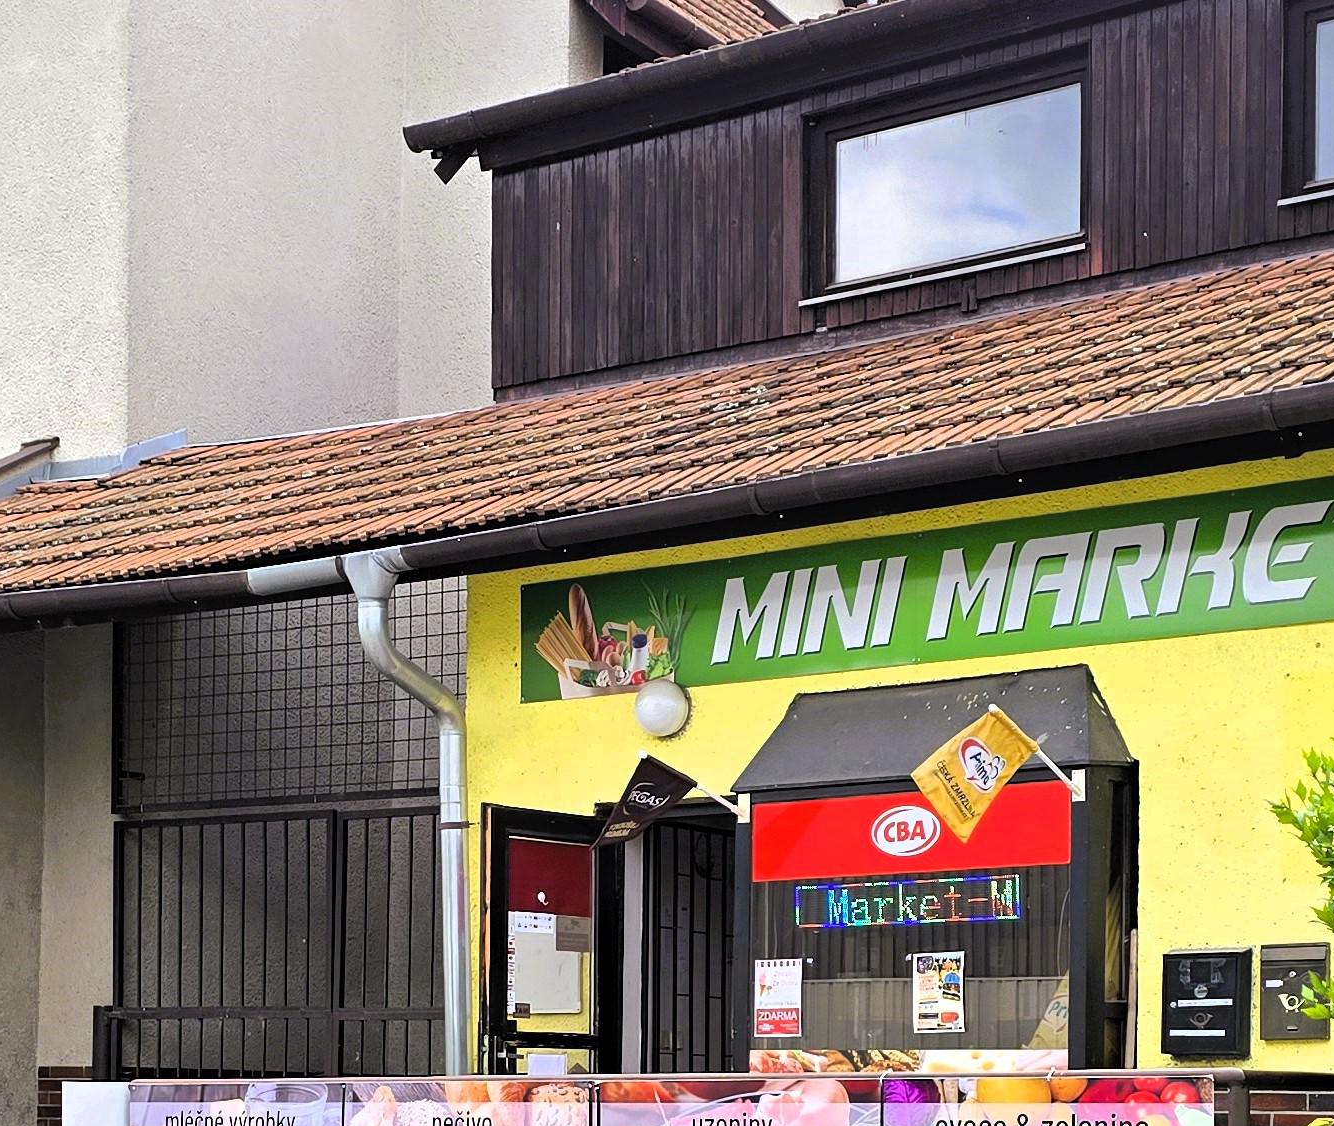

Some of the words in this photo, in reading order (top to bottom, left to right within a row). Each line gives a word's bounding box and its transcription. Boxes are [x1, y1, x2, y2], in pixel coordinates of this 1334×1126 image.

[710, 555, 908, 665] MINI
[883, 820, 927, 843] CBA
[758, 1011, 798, 1021] ZDARMA
